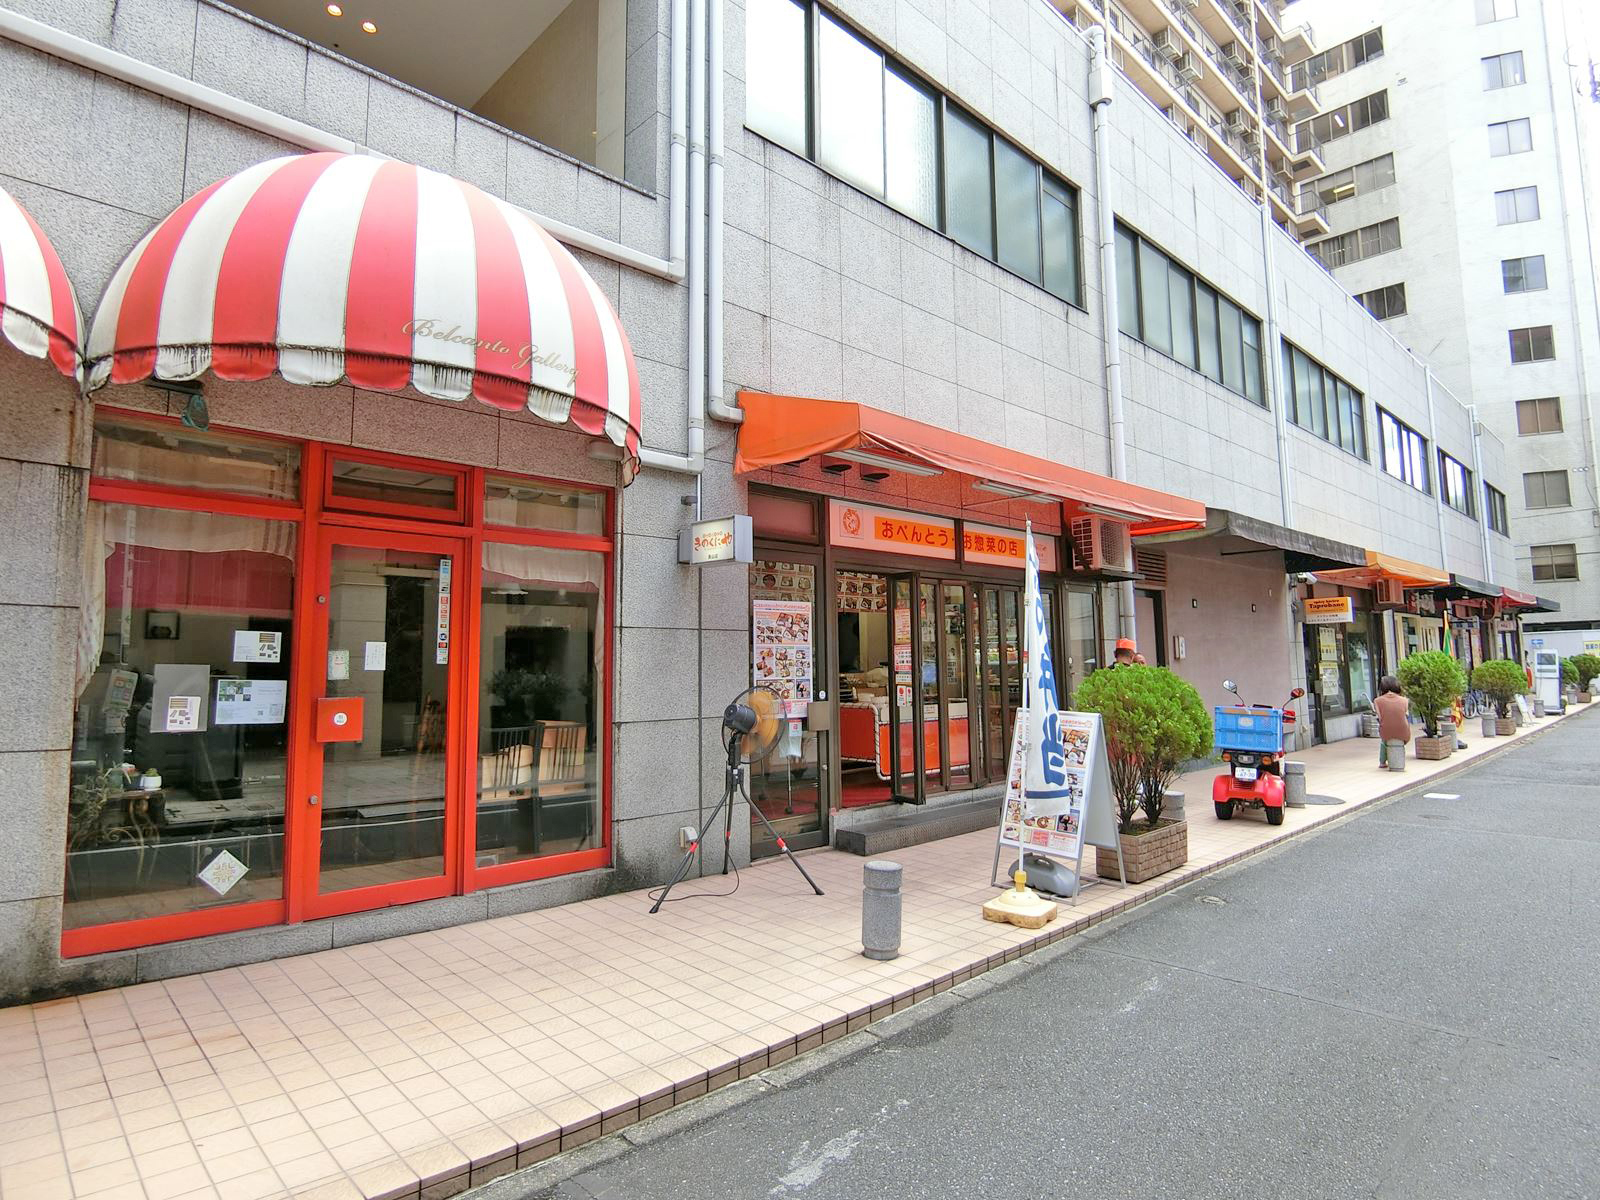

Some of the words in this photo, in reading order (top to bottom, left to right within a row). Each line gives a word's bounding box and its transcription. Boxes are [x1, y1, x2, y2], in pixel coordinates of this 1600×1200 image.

[401, 319, 510, 354] Belcanto
[511, 344, 580, 388] Gallery
[1309, 602, 1345, 610] Taprobane
